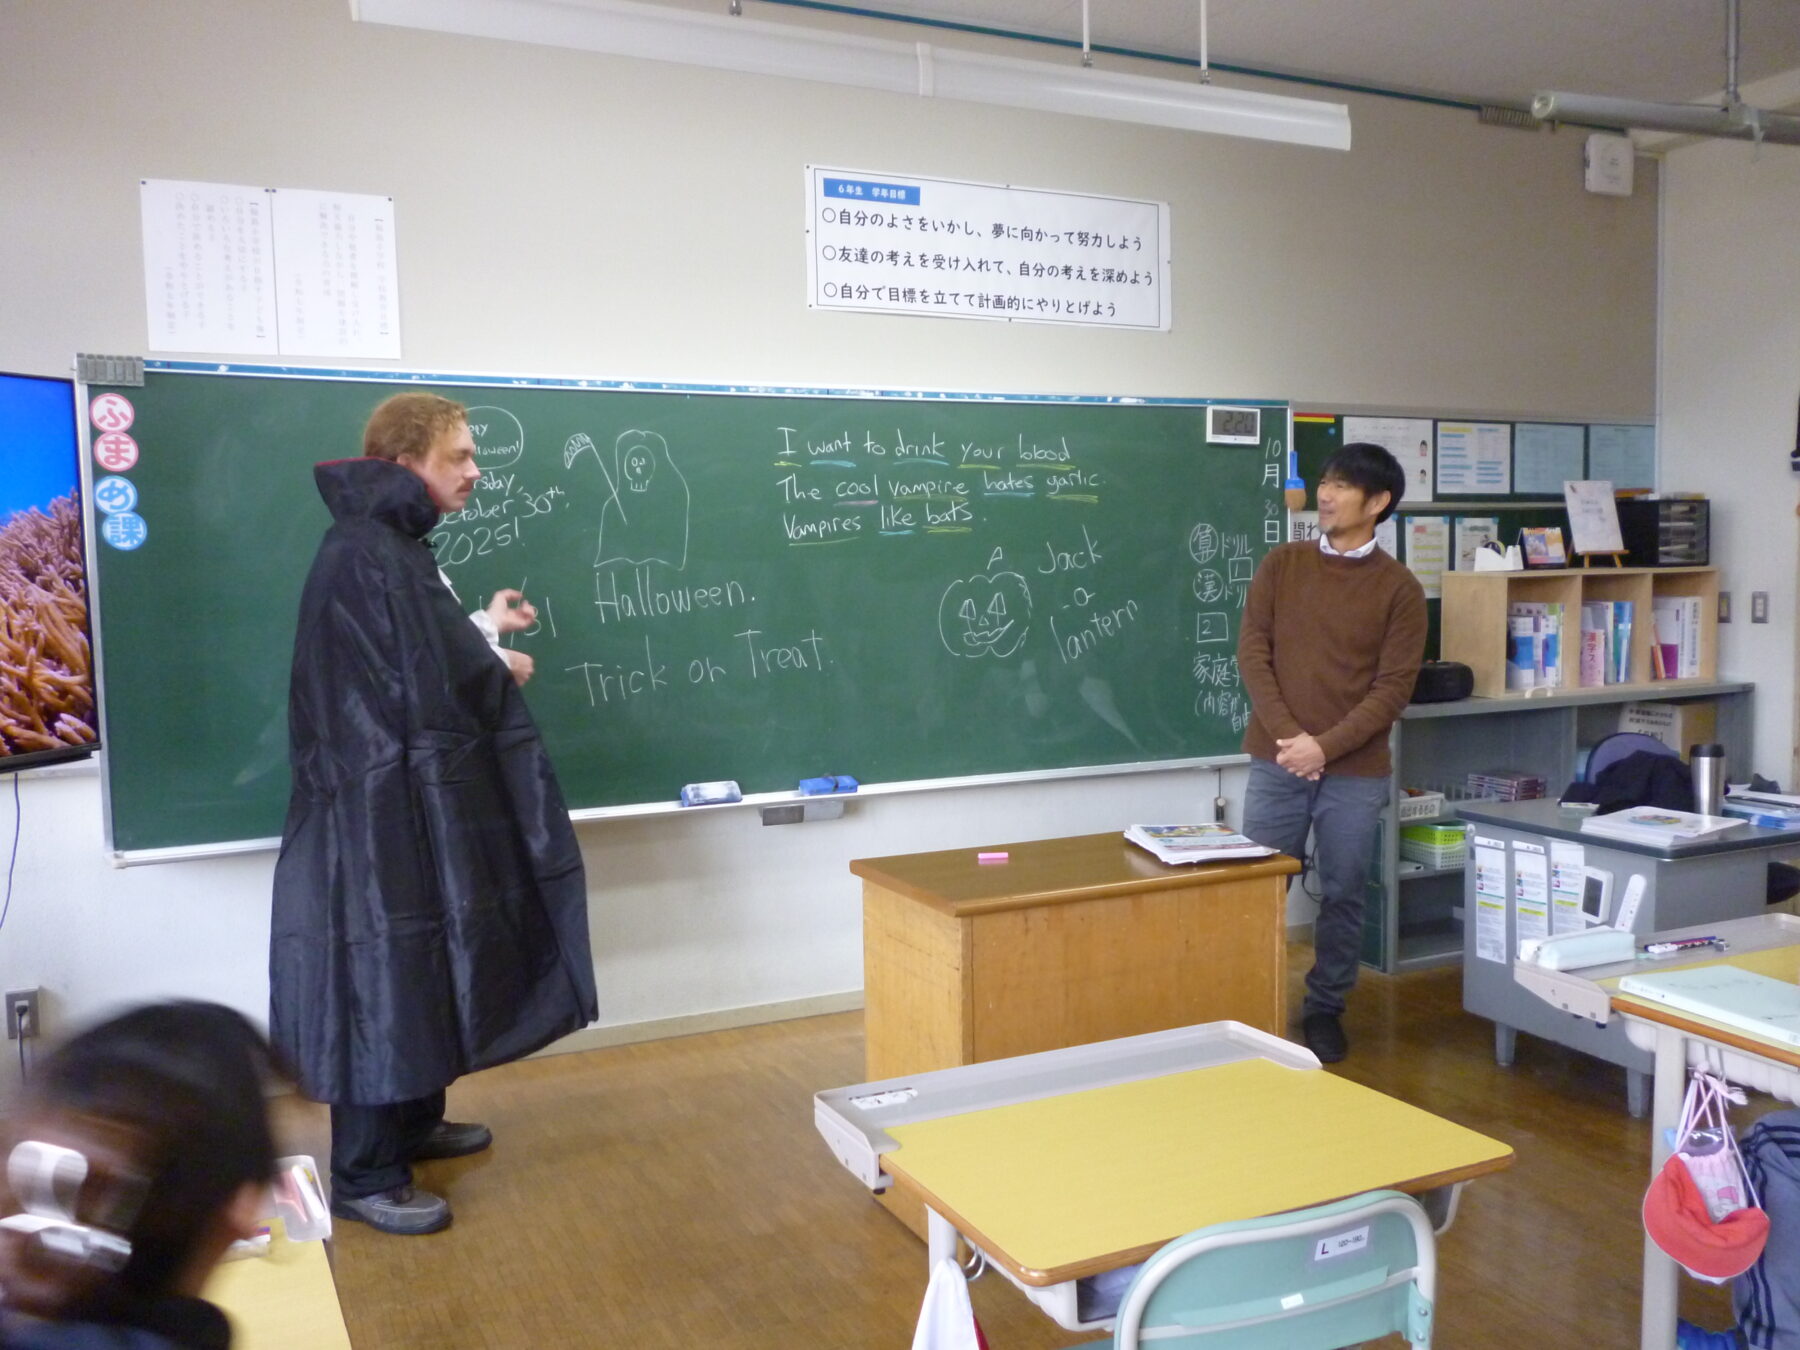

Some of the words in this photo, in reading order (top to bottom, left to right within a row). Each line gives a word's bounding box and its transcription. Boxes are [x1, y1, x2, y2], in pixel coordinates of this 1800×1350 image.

[837, 183, 864, 197] 6年生
[871, 186, 907, 201] 学年目標
[97, 398, 130, 429] ふ
[102, 435, 132, 466] ま
[776, 426, 799, 456] I
[808, 430, 853, 456] want
[864, 430, 886, 457] to
[895, 428, 945, 457] drink
[960, 441, 1005, 464] your
[97, 480, 131, 510] め
[776, 472, 823, 504] The
[836, 474, 879, 498] cool
[984, 470, 1035, 491] hates
[108, 514, 144, 547] 課
[783, 511, 862, 541] Vampires
[880, 504, 917, 530] like
[1038, 524, 1103, 574] Jack
[594, 566, 756, 624] Halloween.
[1050, 598, 1139, 664] lantern
[564, 635, 668, 707] Trick
[1321, 1242, 1329, 1255] L
